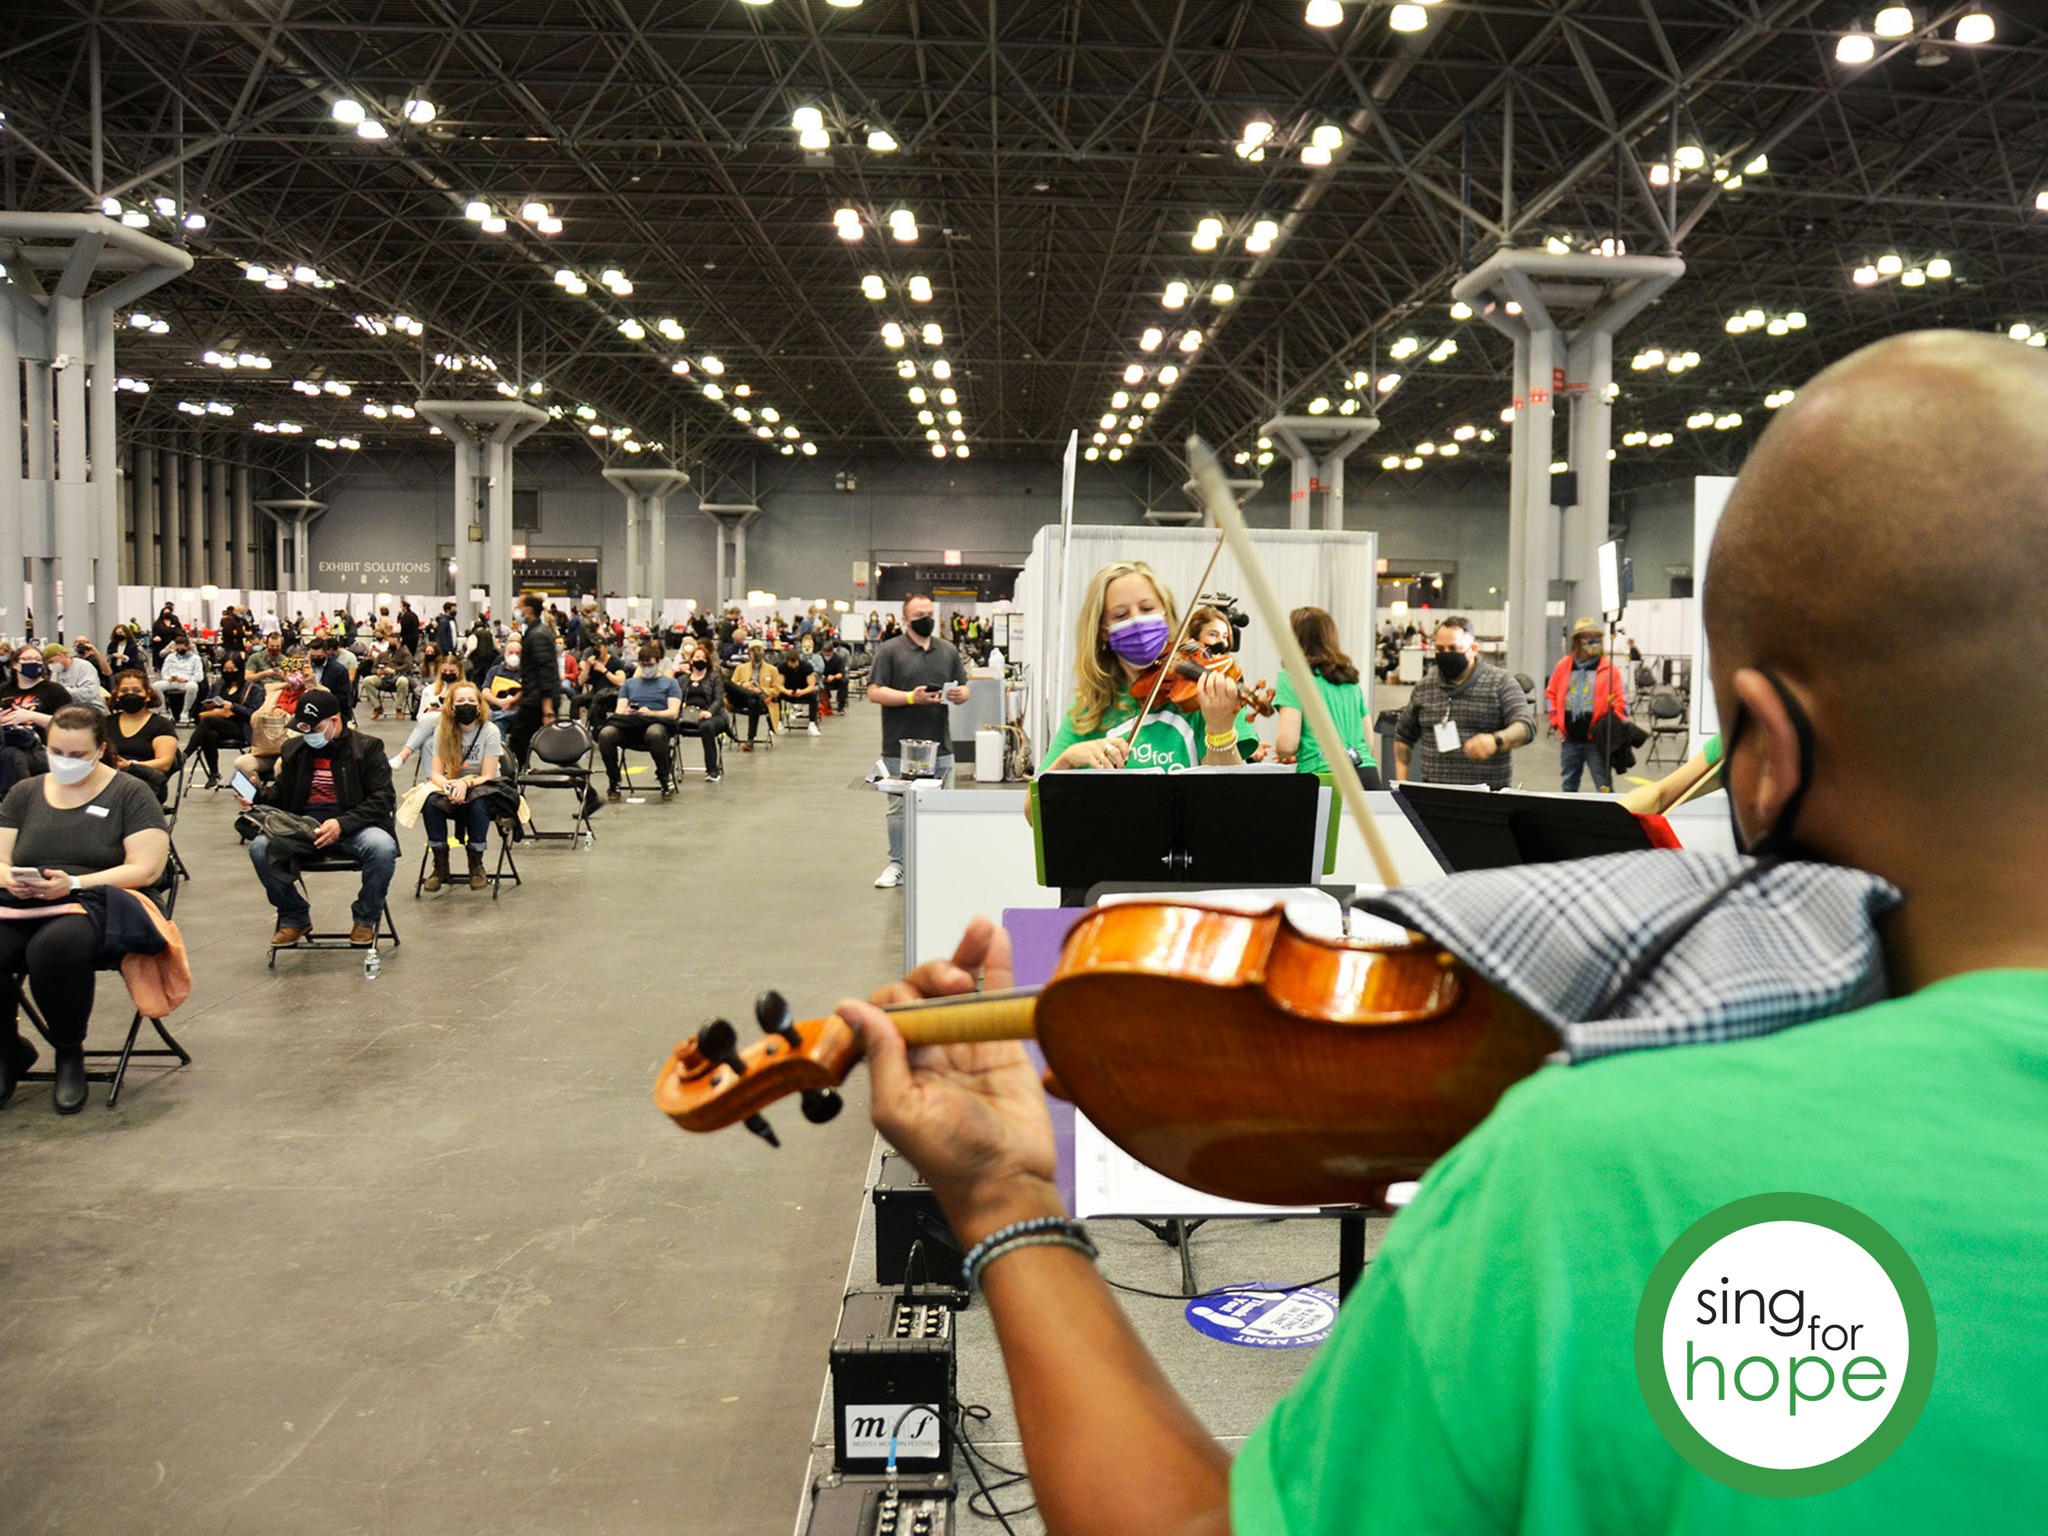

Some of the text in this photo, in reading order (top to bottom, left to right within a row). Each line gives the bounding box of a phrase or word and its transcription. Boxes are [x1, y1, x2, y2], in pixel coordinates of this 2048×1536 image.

[319, 562, 431, 573] EXHIBIT SOLUTIONS
[1131, 744, 1174, 765] ng for
[1230, 1299, 1267, 1318] Thank
[1270, 1312, 1293, 1326] LINE
[1281, 1308, 1316, 1330] WAITING
[1298, 1313, 1325, 1330] WHEN
[1232, 1331, 1329, 1345] FEET APART
